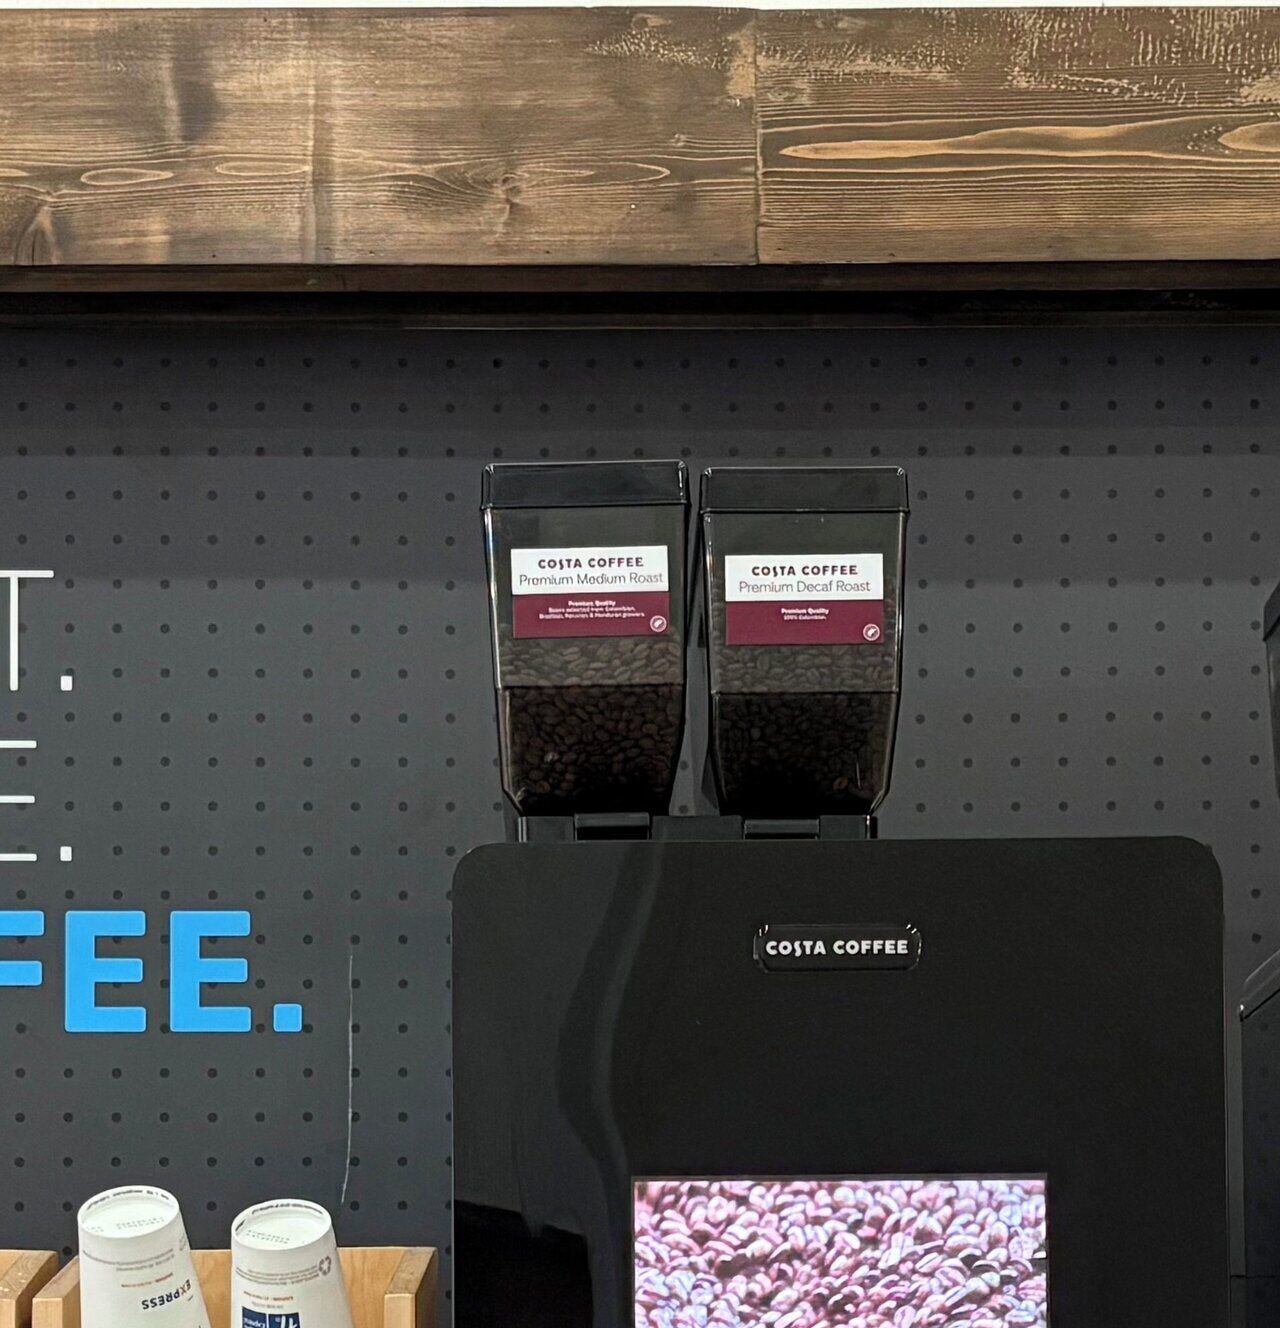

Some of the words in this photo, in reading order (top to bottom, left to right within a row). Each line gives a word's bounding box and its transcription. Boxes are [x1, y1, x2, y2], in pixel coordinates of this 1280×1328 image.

[537, 557, 583, 571] COSTA
[588, 556, 645, 569] COFFEE
[751, 565, 796, 578] COSTA
[801, 564, 859, 576] COFFEE
[519, 573, 574, 587] Premium
[577, 572, 626, 585] Medium
[629, 571, 664, 584] Roast
[738, 580, 794, 593] Premium
[796, 580, 834, 593] Decaf
[836, 580, 871, 592] Roast
[765, 940, 827, 958] COSTA
[832, 939, 909, 956] COFFEE
[141, 1278, 192, 1311] EXPRESS
